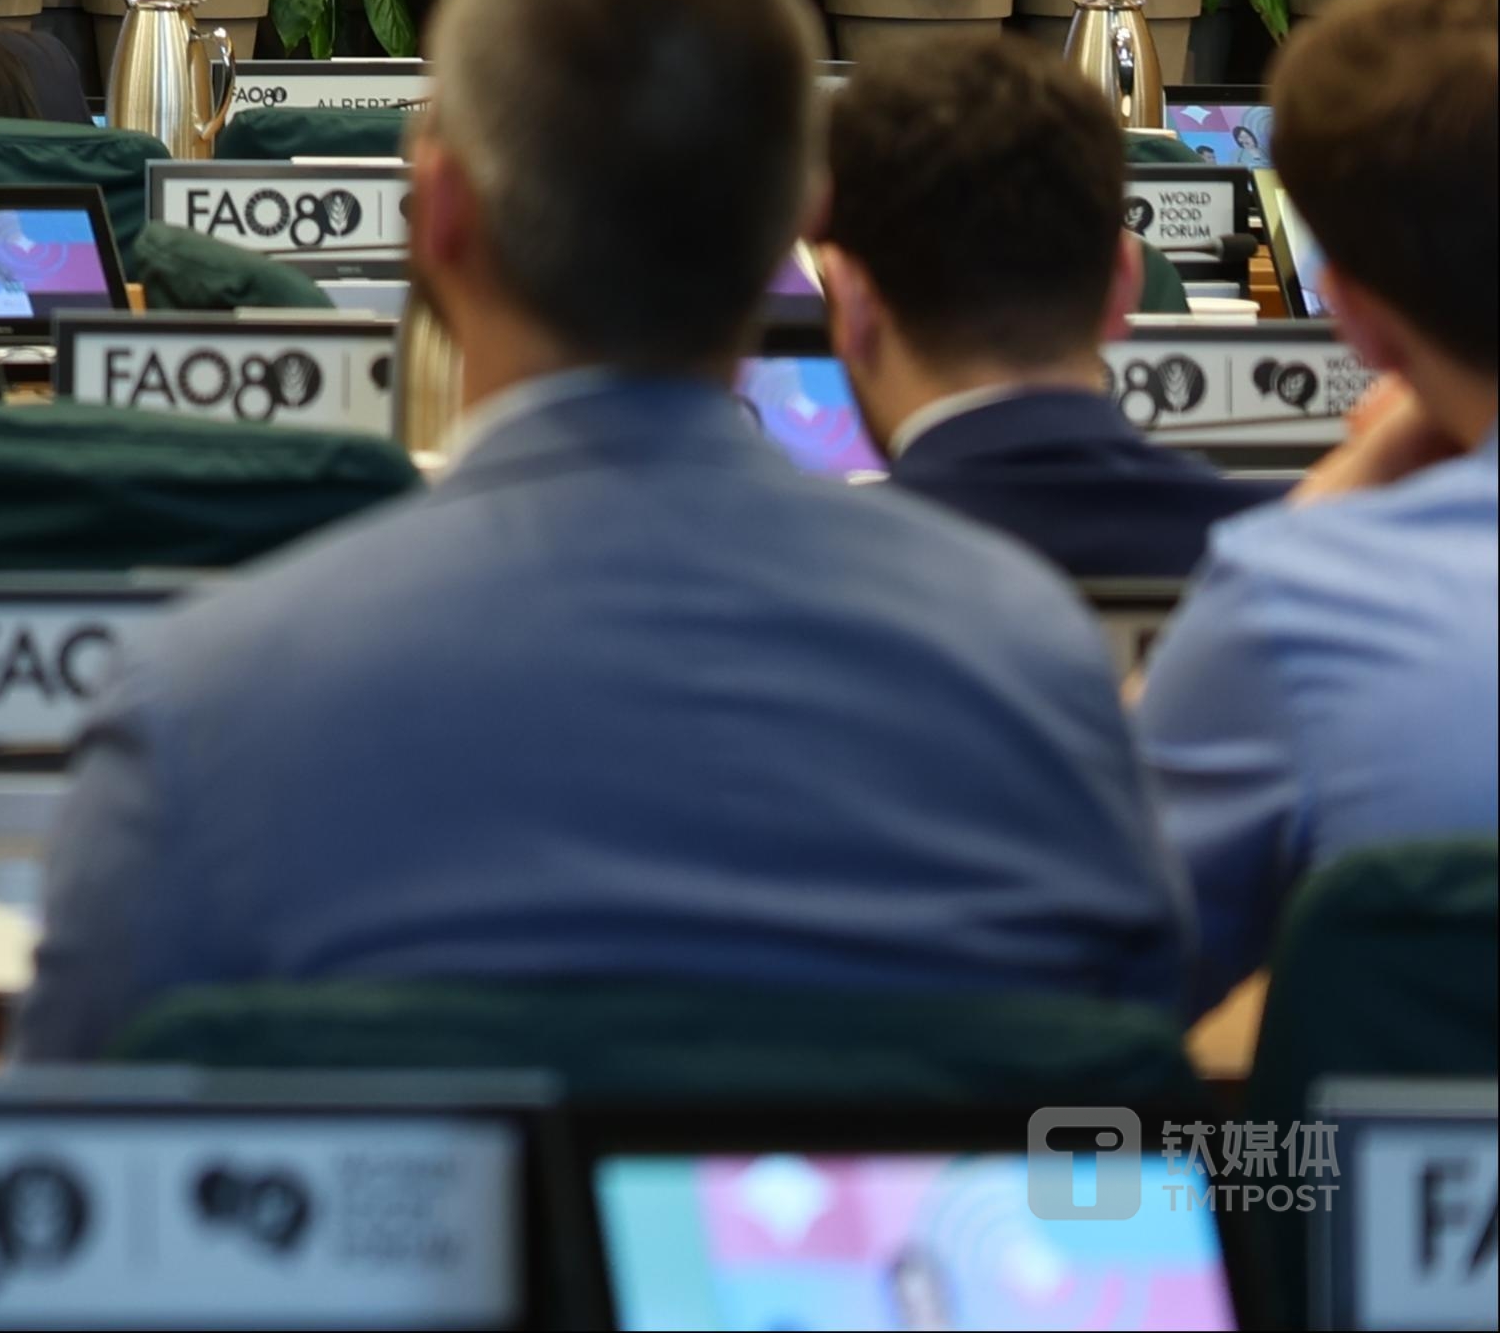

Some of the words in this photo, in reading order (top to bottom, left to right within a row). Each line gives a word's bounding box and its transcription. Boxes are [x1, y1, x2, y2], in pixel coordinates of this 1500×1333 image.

[1158, 191, 1212, 206] WORLD
[1159, 207, 1203, 222] FOOD
[1159, 223, 1212, 239] FORUM
